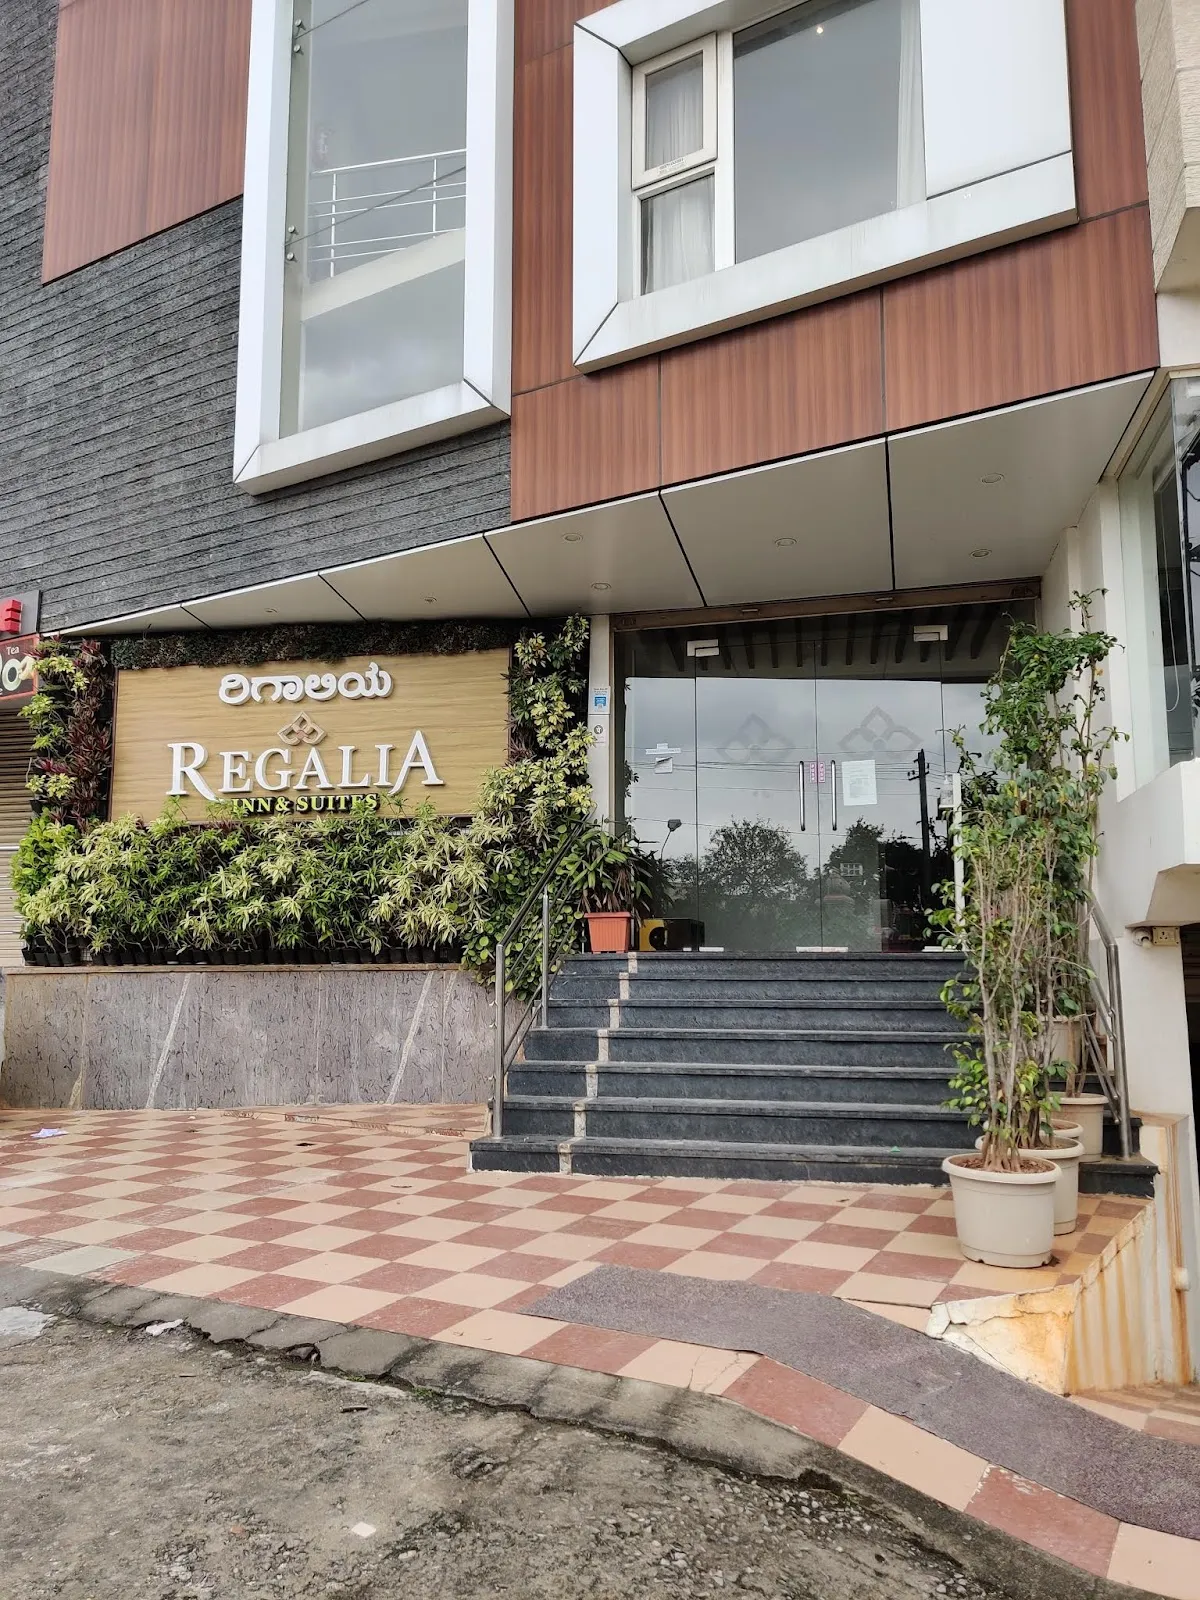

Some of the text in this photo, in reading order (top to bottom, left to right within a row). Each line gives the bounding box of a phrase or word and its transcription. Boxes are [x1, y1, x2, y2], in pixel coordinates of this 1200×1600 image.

[6, 646, 20, 656] Tea
[166, 730, 445, 802] REGALIA
[275, 796, 293, 812] &
